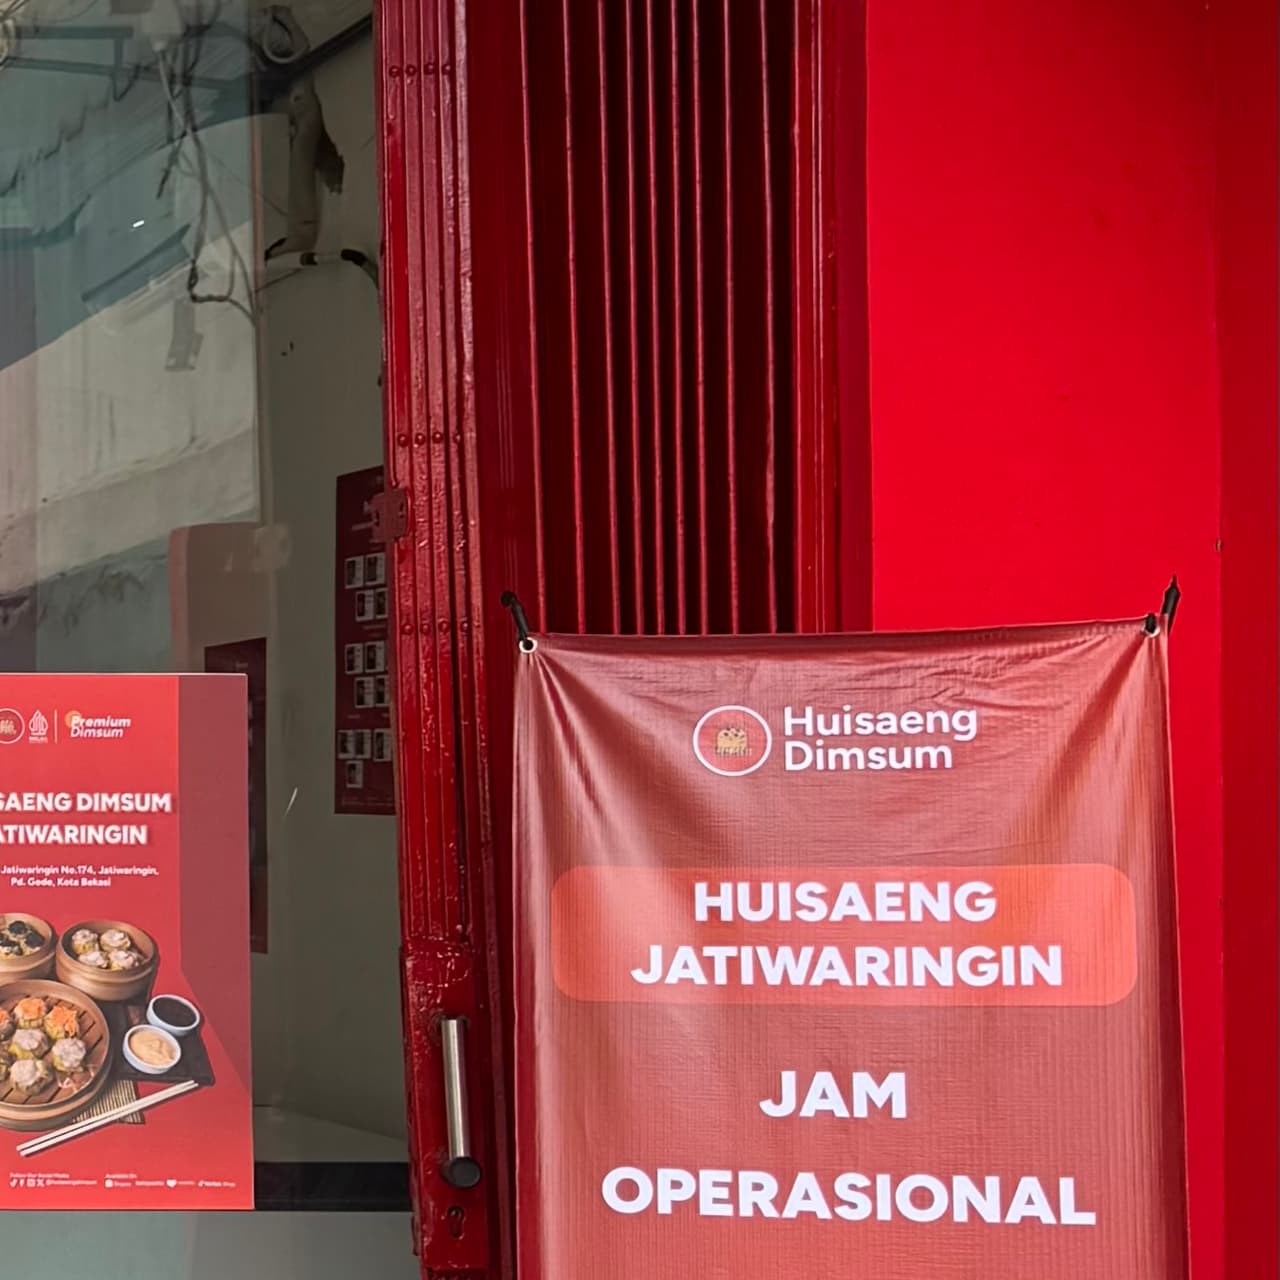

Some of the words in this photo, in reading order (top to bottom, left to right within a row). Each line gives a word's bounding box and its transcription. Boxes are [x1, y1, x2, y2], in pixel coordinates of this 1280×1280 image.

[71, 726, 123, 738] Dimsum
[72, 715, 131, 727] Premium
[784, 704, 978, 741] Huisaeng
[784, 740, 953, 772] Dimsum
[76, 793, 172, 813] DIMSUM
[1, 865, 59, 876] Jatiwaringin
[57, 877, 79, 887] Kota
[81, 877, 112, 887] Bekasi
[694, 881, 997, 922] HUISAENG
[630, 944, 1062, 987] JATIWARINGIN
[759, 1070, 908, 1119] JAM
[601, 1166, 1097, 1225] OPERASIONAL
